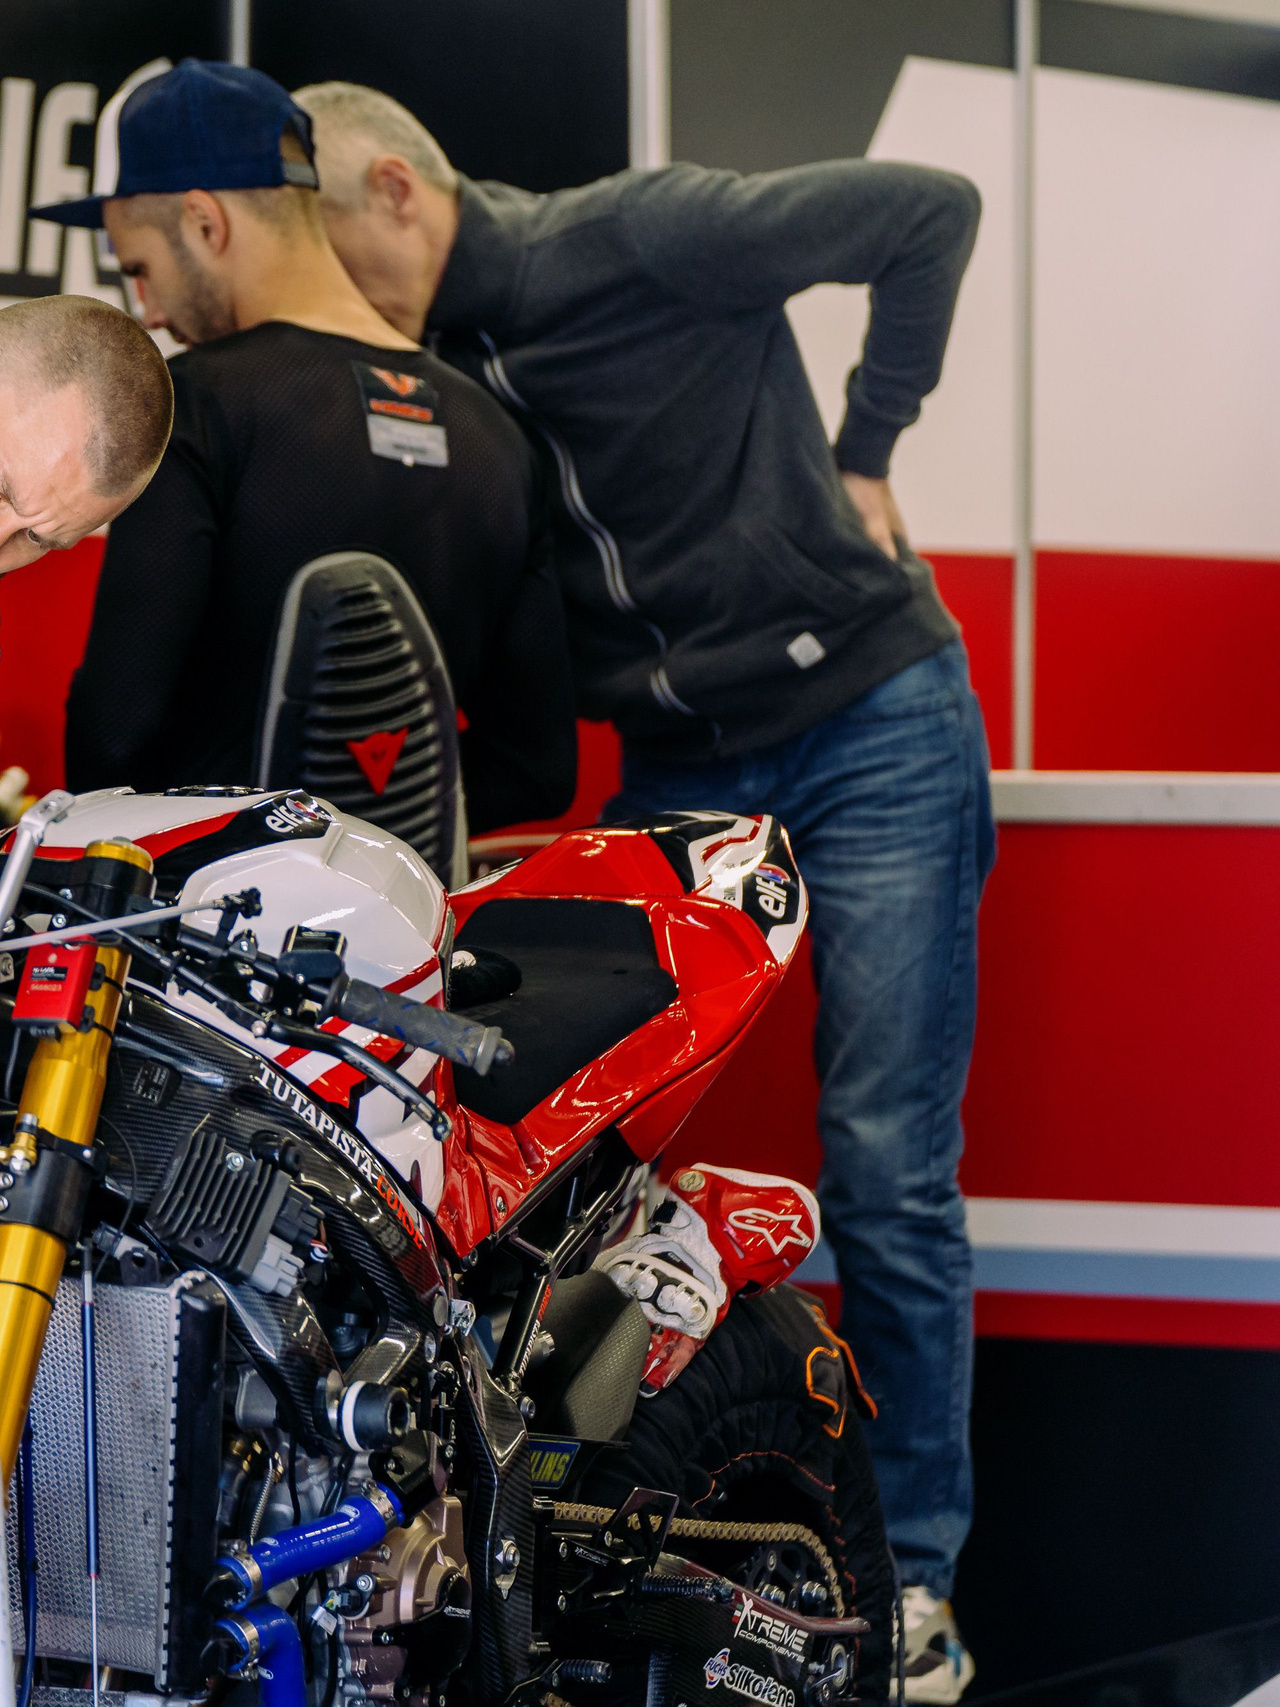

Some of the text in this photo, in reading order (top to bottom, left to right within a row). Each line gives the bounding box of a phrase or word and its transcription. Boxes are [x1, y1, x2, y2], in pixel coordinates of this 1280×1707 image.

[265, 803, 304, 834] elf
[756, 875, 788, 919] elf
[258, 1062, 423, 1250] TUTAPISTA CORSE
[738, 1629, 806, 1664] COMPONENTS
[705, 1659, 796, 1707] FUCHS Silkolene
